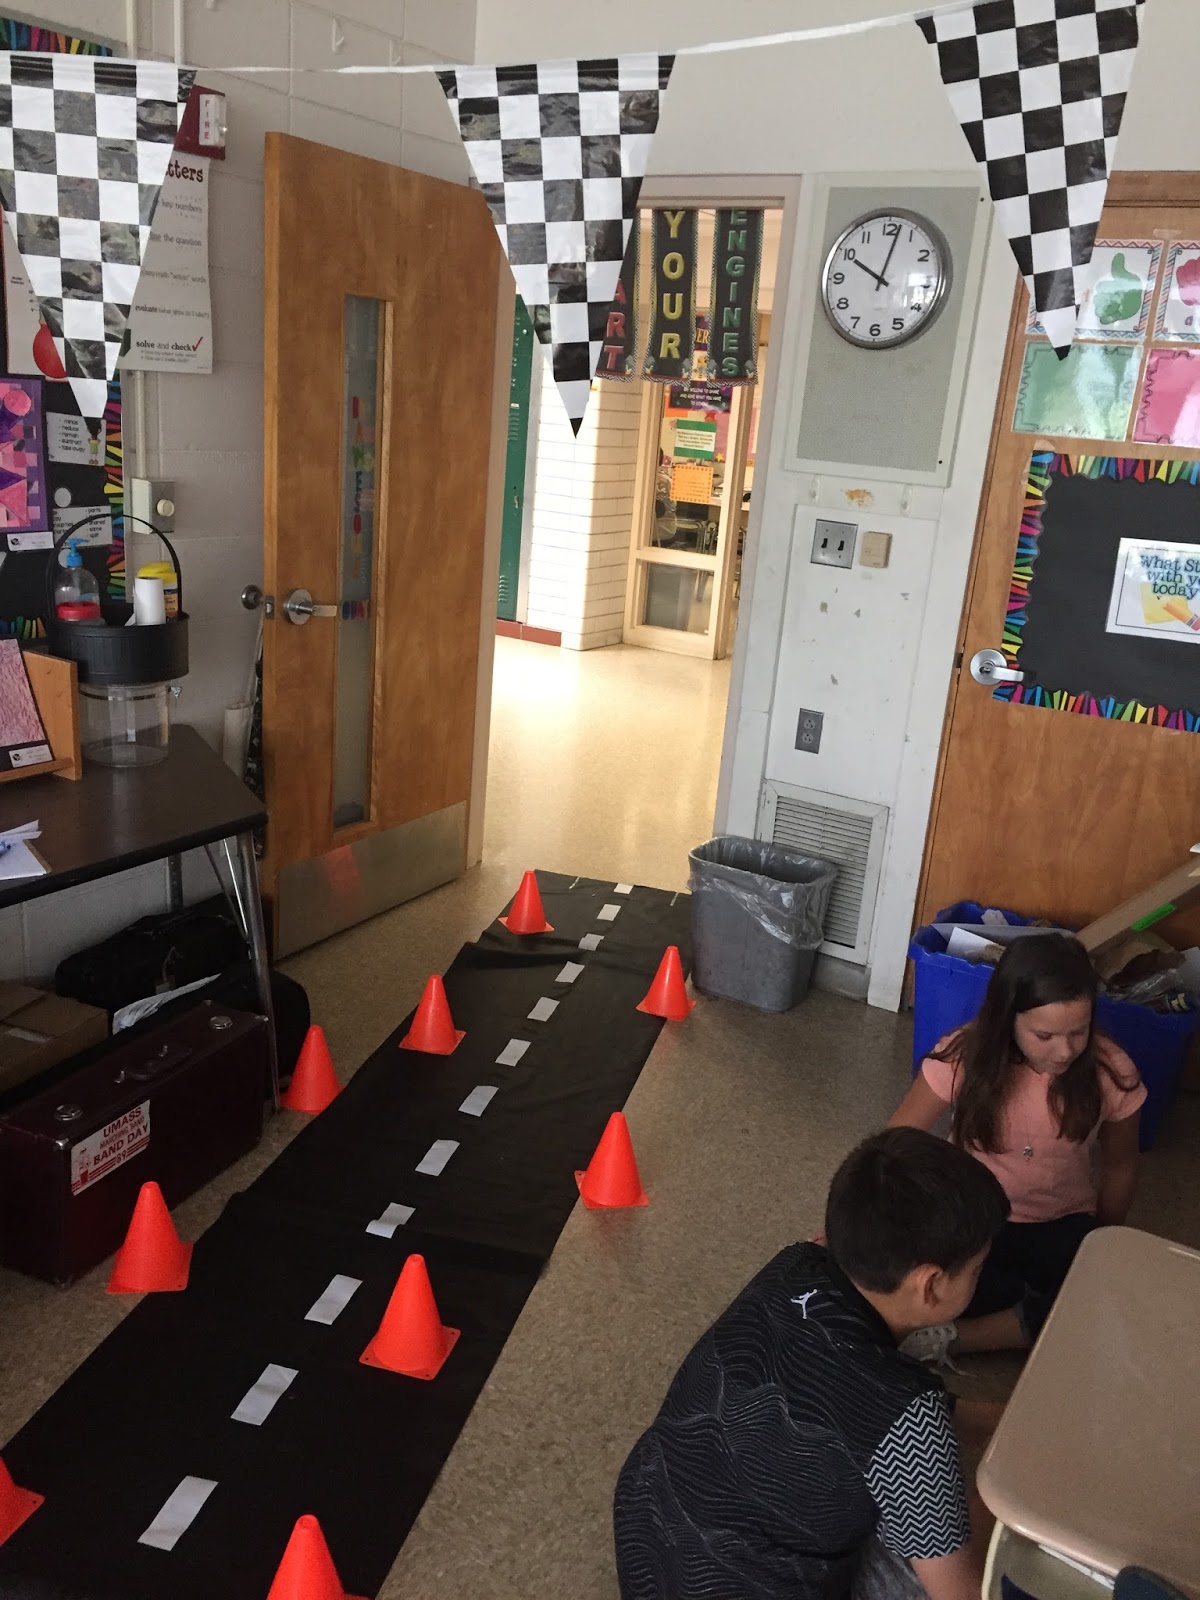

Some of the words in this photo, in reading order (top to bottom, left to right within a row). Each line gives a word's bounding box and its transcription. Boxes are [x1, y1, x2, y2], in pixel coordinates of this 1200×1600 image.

[166, 159, 204, 182] tters
[175, 202, 203, 213] numbers
[882, 222, 898, 236] 12
[843, 248, 855, 261] 10
[917, 249, 930, 262] 2
[659, 211, 685, 359] YOUR
[832, 272, 845, 285] 9
[721, 209, 748, 376] ENGINES
[836, 297, 849, 310] 8
[604, 277, 626, 370] ART
[850, 316, 861, 329] 7
[891, 318, 904, 331] 5
[869, 324, 881, 337] 6
[136, 340, 155, 348] solve
[157, 342, 169, 350] and
[171, 342, 192, 351] check
[1140, 554, 1181, 571] What
[1184, 558, 1200, 573] St
[1147, 570, 1183, 584] with
[1153, 582, 1198, 600] today
[103, 1106, 142, 1138] UMASS
[93, 1140, 124, 1166] BAND
[127, 1122, 148, 1144] DAY
